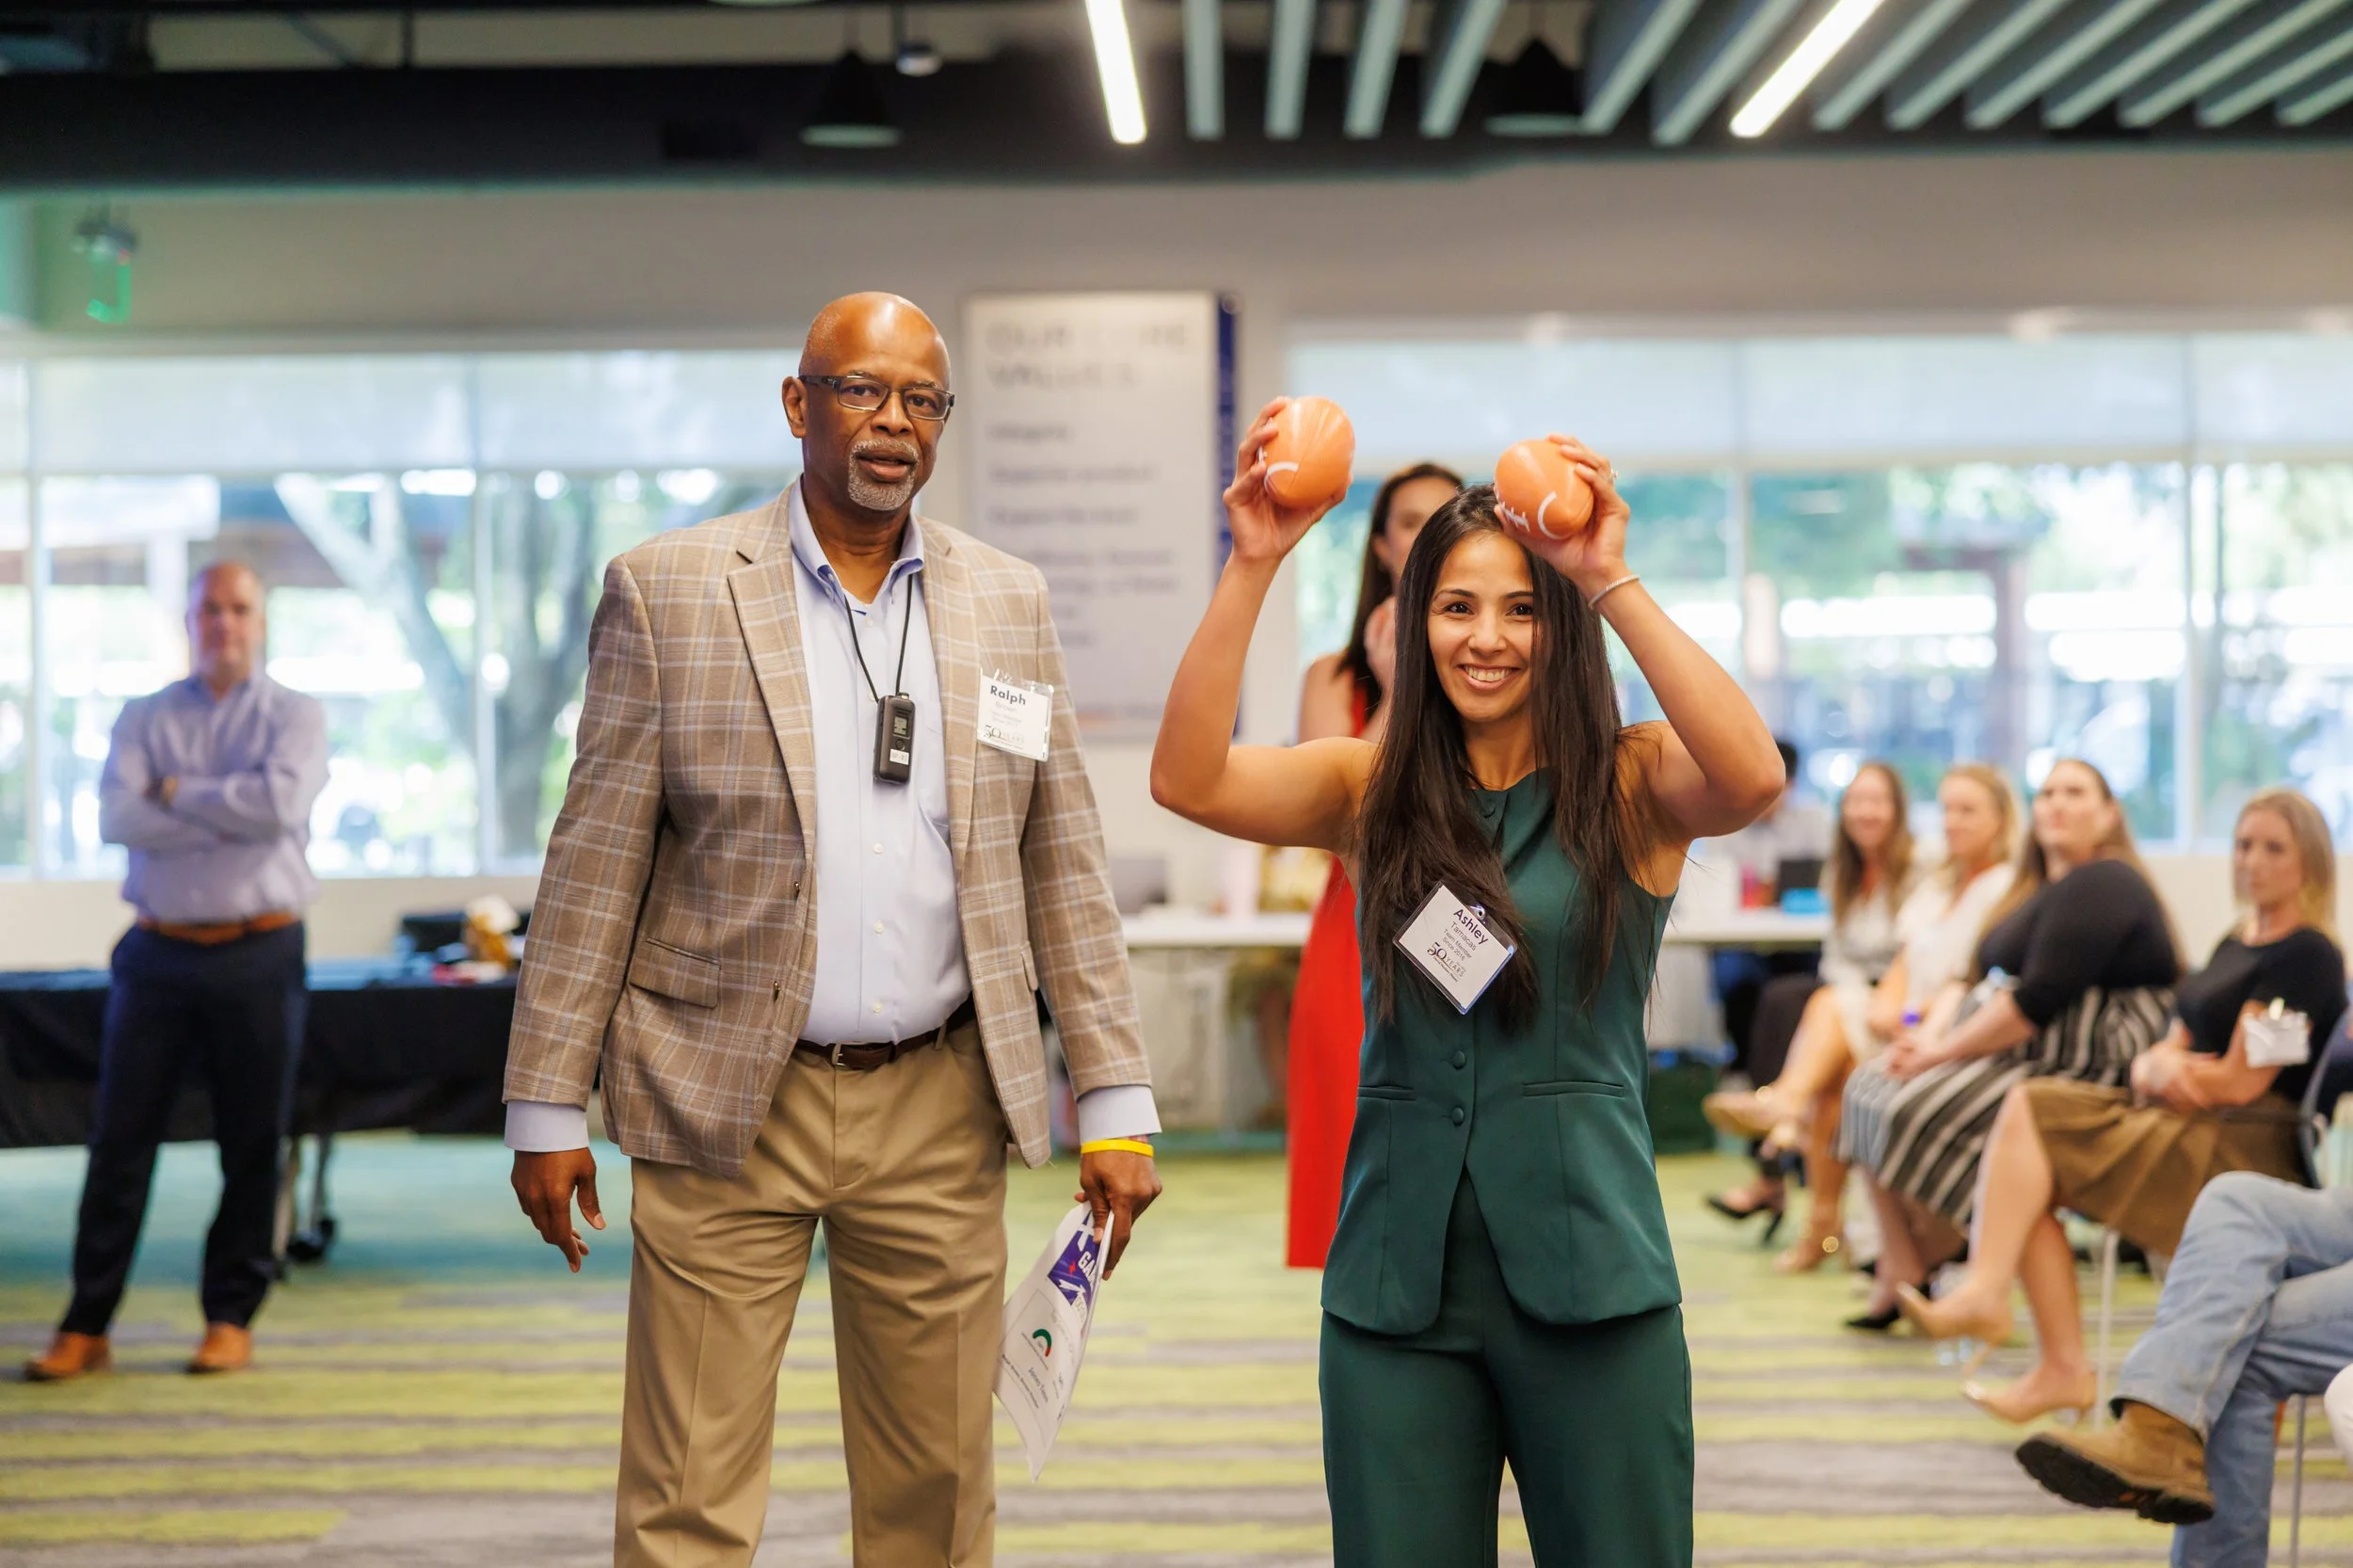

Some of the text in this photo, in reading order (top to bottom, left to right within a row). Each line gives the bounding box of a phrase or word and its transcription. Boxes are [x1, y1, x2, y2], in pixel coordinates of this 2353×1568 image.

[990, 685, 1026, 705] Ralph
[1444, 929, 1456, 942] Team
[1450, 921, 1477, 951] Tamacas
[1453, 909, 1488, 944] Ashley
[1427, 941, 1448, 961] 50
[1446, 958, 1465, 977] YEARS
